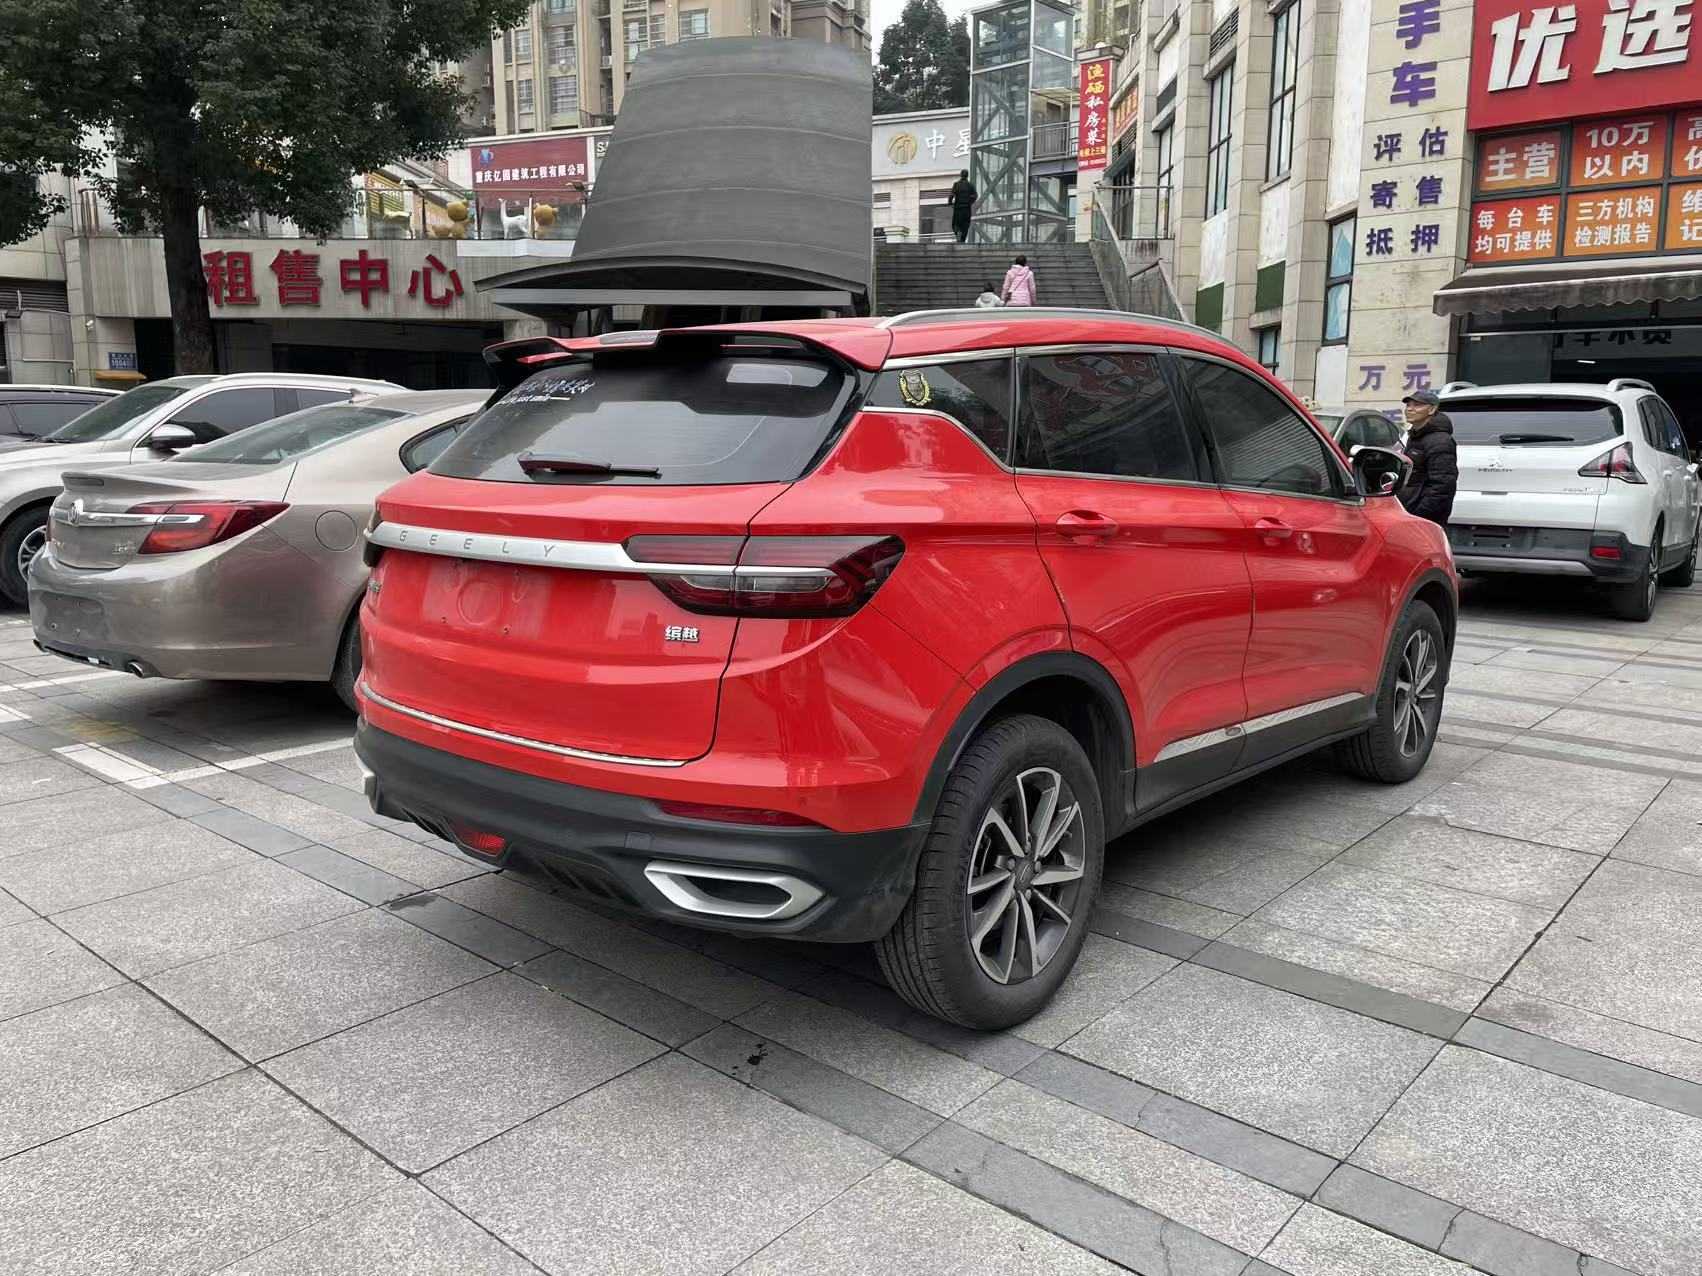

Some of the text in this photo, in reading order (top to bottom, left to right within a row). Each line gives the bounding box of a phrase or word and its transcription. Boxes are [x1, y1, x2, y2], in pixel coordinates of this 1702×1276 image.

[1488, 0, 1693, 92] 优选
[1373, 126, 1448, 162] 评估
[1586, 122, 1654, 148] 10万
[1485, 143, 1555, 183] 主营
[1583, 150, 1649, 178] 以内
[1370, 175, 1443, 209] 寄售
[1477, 204, 1554, 230] 每台车
[1576, 196, 1654, 221] 三方机构
[1366, 223, 1440, 255] 抵押
[1475, 231, 1553, 254] 均可提供
[1574, 222, 1652, 248] 检测报告
[203, 249, 464, 308] 租售中心
[1358, 364, 1431, 391] 万元
[399, 530, 555, 557] GEELY
[665, 625, 699, 643] 缤越
